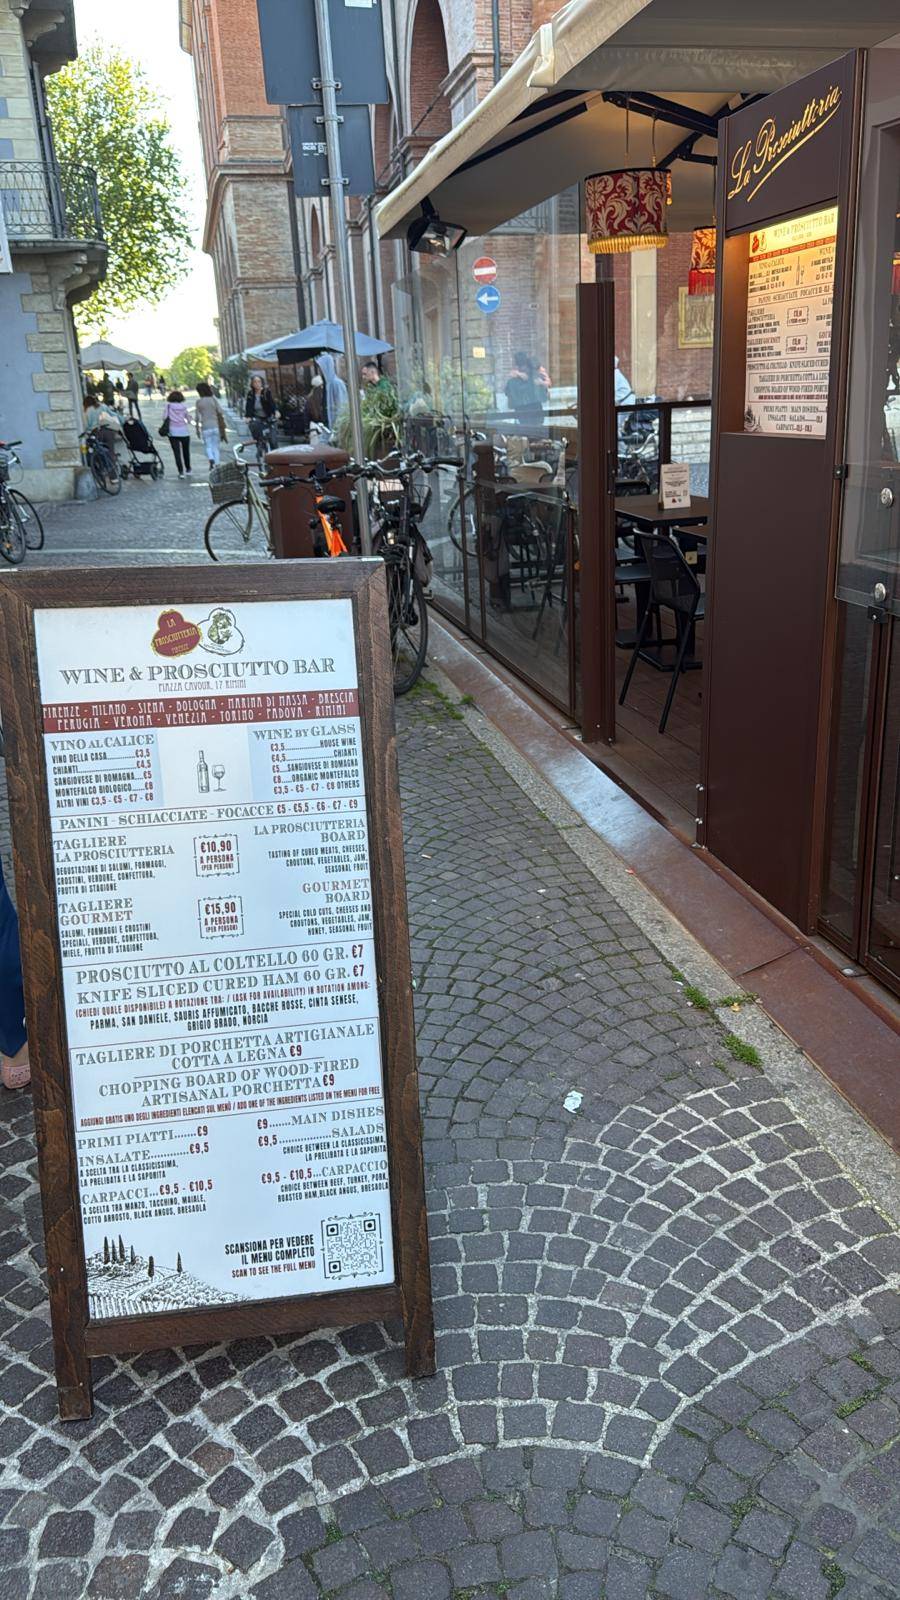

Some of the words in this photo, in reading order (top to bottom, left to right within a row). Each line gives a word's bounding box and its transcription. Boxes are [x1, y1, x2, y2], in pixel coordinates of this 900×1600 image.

[728, 140, 752, 199] La
[753, 86, 842, 173] Prosciutteria
[166, 618, 176, 628] LA
[59, 667, 125, 685] WINE
[128, 666, 142, 682] &
[148, 660, 288, 681] PROSCIUTTO
[292, 658, 335, 674] BAR
[92, 703, 126, 716] MILANO
[137, 701, 165, 714] SIENA
[176, 699, 217, 711] BOLOGNA
[227, 697, 262, 709] MARINA
[265, 696, 275, 707] DI
[278, 694, 307, 706] MASSA
[318, 692, 353, 704] BRESCIA
[56, 717, 100, 730] PERUGIA
[113, 715, 152, 727] VERONA
[165, 712, 207, 724] VENEZIA
[220, 709, 254, 721] TORINO
[266, 707, 303, 719] PADOVA
[315, 704, 346, 716] RIMINI
[252, 728, 292, 740] WINE
[295, 729, 309, 737] BY
[310, 724, 355, 736] GLASS
[51, 739, 86, 750] VINO
[88, 740, 104, 748] AL
[103, 734, 154, 746] CALICE
[52, 755, 66, 763] VINO
[69, 753, 88, 762] DELLA
[90, 751, 106, 760] CASA
[53, 766, 78, 774] CHIANTI
[54, 776, 93, 785] SANGIOVESE
[95, 774, 101, 782] DI
[103, 772, 134, 781] ROMAGNA
[56, 799, 73, 808] ALTRI
[76, 798, 89, 806] VINI
[113, 795, 122, 803] €5
[128, 793, 137, 802] €7
[144, 792, 153, 800] €8
[59, 816, 108, 829] PANINI
[118, 809, 207, 825] SCHIACCIATE
[217, 805, 273, 817] FOCACCE
[276, 804, 285, 813] €5
[316, 801, 325, 810] €6
[332, 800, 341, 809] €7
[348, 799, 357, 808] €9
[254, 825, 270, 835] LA
[271, 818, 364, 833] PROSCIUTTERIA
[320, 829, 365, 842] BOARD
[53, 835, 126, 850] TAGLIERE
[54, 852, 71, 862] LA
[73, 844, 174, 861] PROSCIUTTERIA
[302, 878, 369, 893] GOURMET
[58, 898, 132, 913] TAGLIERE
[325, 890, 370, 903] BOARD
[59, 910, 132, 926] GOURMET
[75, 961, 184, 984] PROSCIUTTO
[188, 959, 209, 974] AL
[213, 951, 297, 971] COLTELLO
[301, 949, 318, 963] 60
[322, 945, 348, 961] GR.
[351, 943, 363, 958] €7
[76, 988, 132, 1004] KNIFE
[136, 981, 199, 998] SLICED
[202, 975, 258, 992] CURED
[262, 971, 298, 986] HAM
[302, 969, 320, 982] 60
[324, 966, 350, 979] GR.
[352, 964, 365, 976] €7
[90, 1017, 118, 1029] PARMA,
[121, 1015, 136, 1026] SAN
[138, 1012, 171, 1025] DANIELE,
[173, 1009, 200, 1021] SAURIS
[202, 1004, 249, 1018] AFFUMICATO,
[251, 1001, 278, 1013] BACCHE
[281, 998, 305, 1011] ROSSE,
[308, 996, 328, 1008] CINTA
[330, 993, 358, 1006] SENESE,
[187, 1019, 211, 1031] GRIGIO
[213, 1016, 239, 1028] BRADO,
[242, 1013, 268, 1025] NORCIA
[75, 1046, 155, 1065] TAGLIERE
[158, 1044, 176, 1057] DI
[180, 1034, 270, 1054] PORCHETTA
[274, 1023, 375, 1044] ARTIGIANALE
[171, 1053, 219, 1069] COTTA
[223, 1052, 233, 1064] A
[236, 1046, 287, 1062] LEGNA
[289, 1044, 302, 1057] €9
[98, 1076, 181, 1097] CHOPPING
[184, 1070, 236, 1087] BOARD
[240, 1068, 260, 1081] OF
[263, 1057, 359, 1078] WOOD-FIRED
[141, 1086, 229, 1107] ARTISANAL
[232, 1076, 321, 1096] PORCHETTA
[322, 1073, 334, 1086] €9
[257, 1118, 268, 1129] €9
[290, 1111, 327, 1125] MAIN
[331, 1105, 383, 1120] DISHES
[77, 1135, 121, 1149] PRIMI
[126, 1129, 174, 1144] PIATTI
[197, 1125, 208, 1136] €9
[331, 1122, 384, 1138] SALADS
[78, 1149, 150, 1167] INSALATE
[321, 1159, 387, 1176] CARPACCIO
[81, 1187, 149, 1204] CARPACCI
[224, 1239, 267, 1254] SCANSIONA
[269, 1237, 283, 1249] PER
[286, 1234, 314, 1247] VEDERE
[241, 1254, 248, 1265] IL
[250, 1251, 272, 1264] MENU
[275, 1246, 314, 1261] COMPLETO
[231, 1268, 247, 1278] SCAN
[249, 1267, 256, 1276] TO
[258, 1265, 269, 1274] SEE
[271, 1264, 281, 1273] THE
[283, 1262, 295, 1271] FULL
[298, 1259, 315, 1269] MENU
